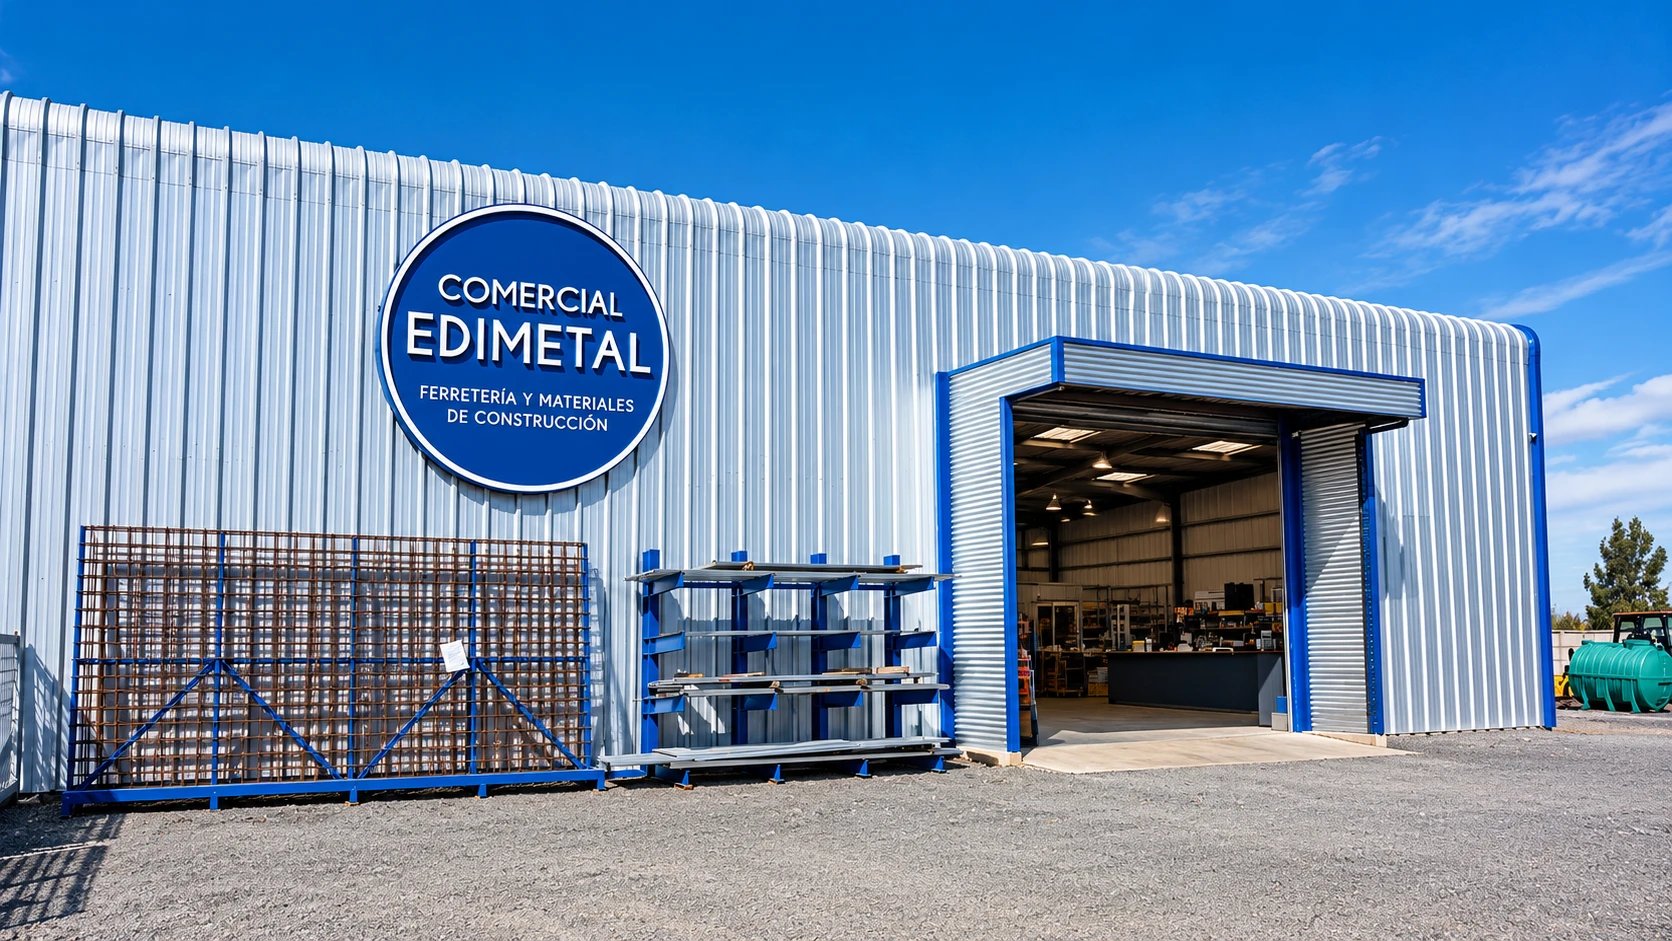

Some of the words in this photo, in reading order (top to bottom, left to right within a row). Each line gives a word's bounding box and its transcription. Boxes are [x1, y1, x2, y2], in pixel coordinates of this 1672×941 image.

[438, 274, 623, 317] COMERCIAL
[406, 311, 651, 373] EDIMETAL
[420, 385, 517, 405] FERRETERÍA
[522, 392, 533, 406] Y
[539, 393, 634, 412] MATERIALES
[447, 408, 468, 424] DE
[474, 410, 608, 431] CONSTRUCCIÓN
